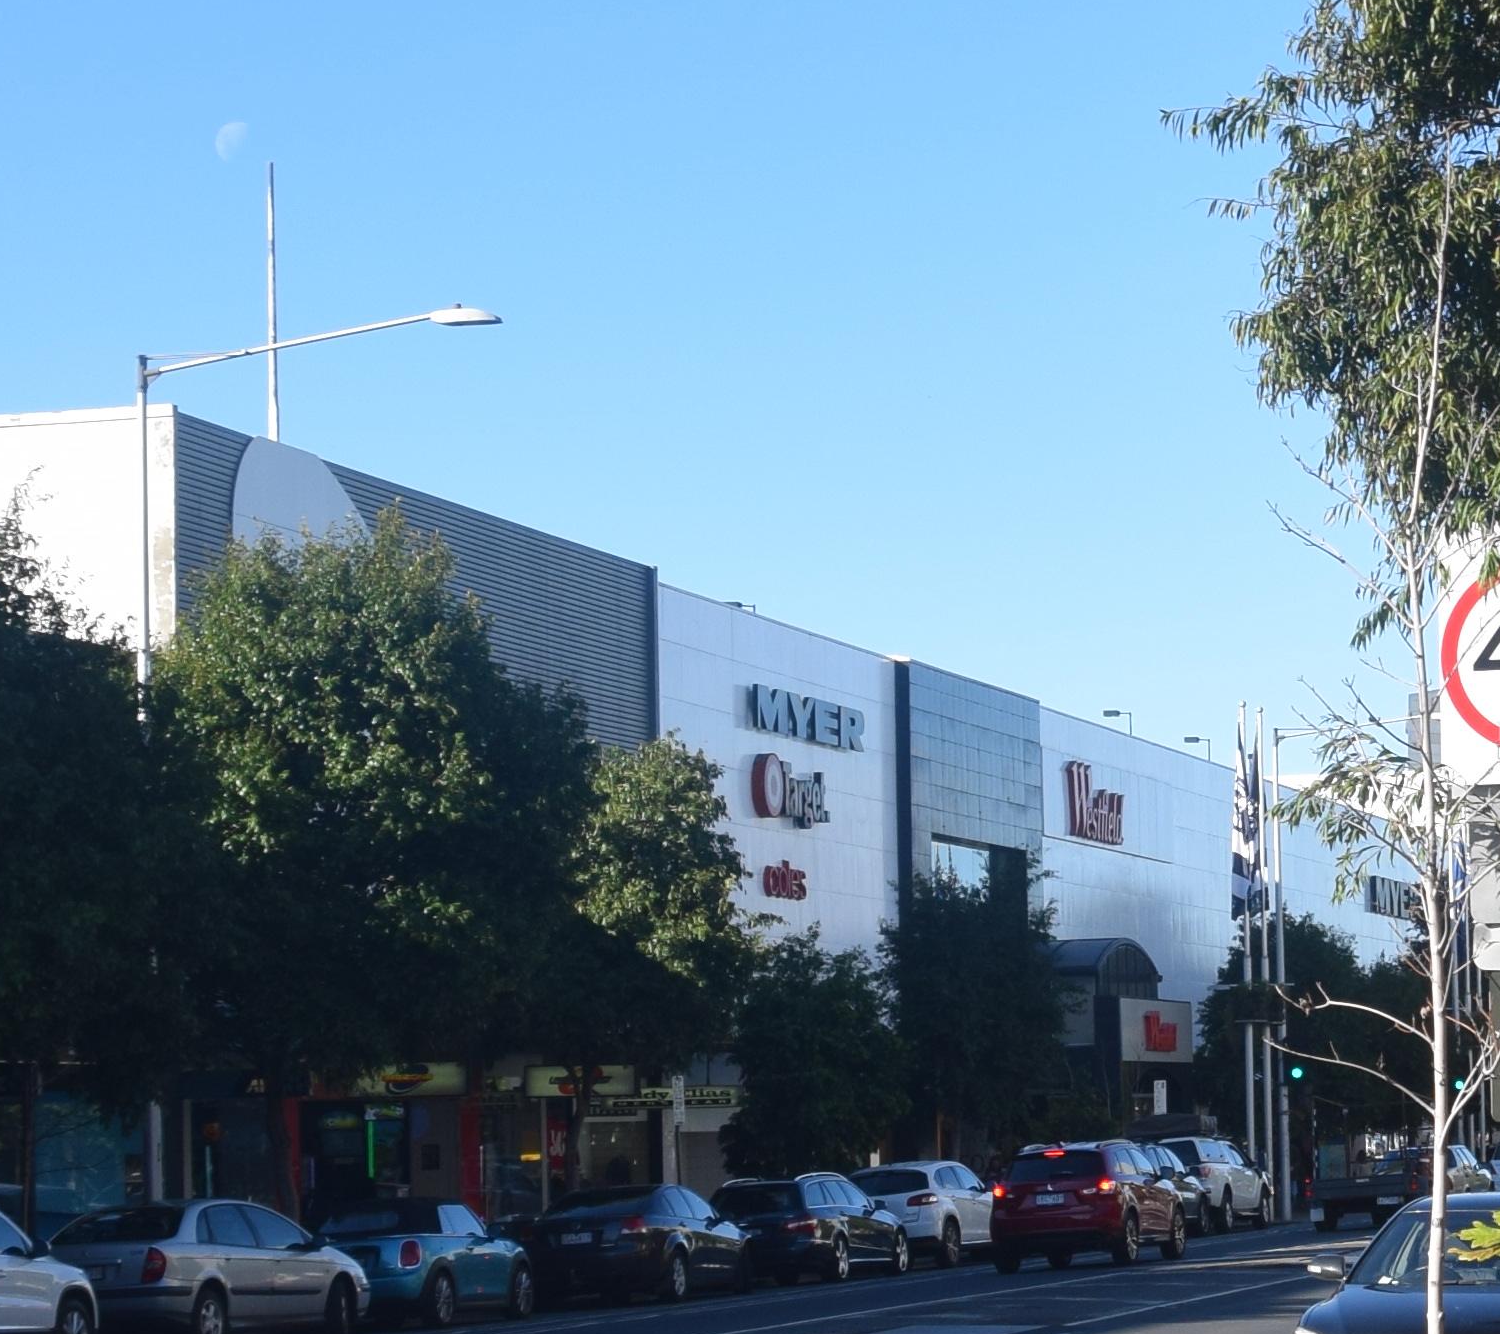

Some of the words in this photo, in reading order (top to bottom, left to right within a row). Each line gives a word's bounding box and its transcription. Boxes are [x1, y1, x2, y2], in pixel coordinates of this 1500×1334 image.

[753, 683, 864, 753] MYER
[1067, 761, 1124, 845] Westfield
[763, 859, 807, 900] coles
